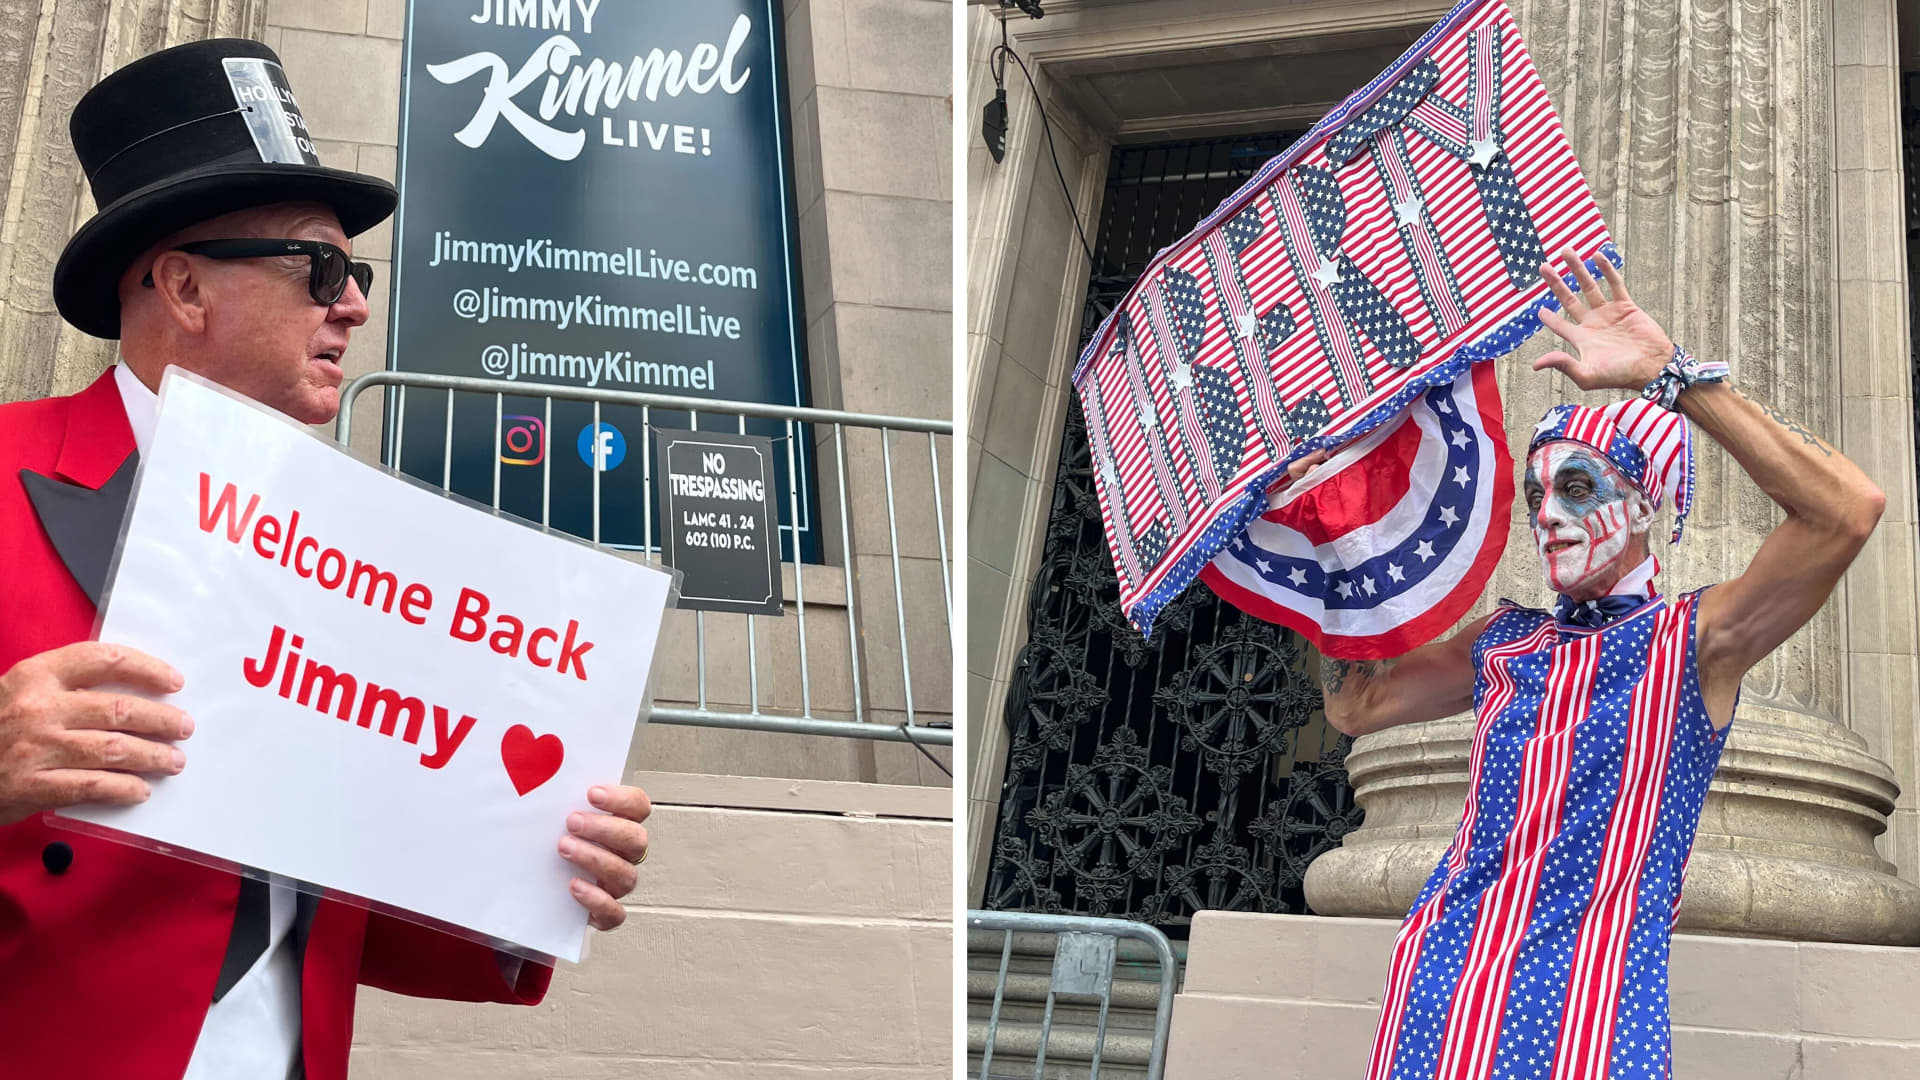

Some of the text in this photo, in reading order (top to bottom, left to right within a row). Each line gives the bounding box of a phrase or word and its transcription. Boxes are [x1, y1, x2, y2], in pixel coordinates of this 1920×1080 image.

[470, 0, 600, 34] JIMMY
[426, 13, 751, 161] Kimmel
[602, 117, 711, 156] LIVE!
[430, 232, 757, 289] JimmyKimmelLive.com
[453, 287, 740, 339] @JimmyKimmelLive
[1083, 23, 1548, 592] LIBERTY
[481, 343, 714, 390] @JimmyKimmel
[702, 451, 726, 475] NO
[670, 473, 764, 502] TRESPASSING
[683, 510, 716, 527] LAMC
[685, 531, 755, 550] 602 (10) P.C.
[199, 472, 595, 681] Welcome Back
[242, 624, 478, 769] Jimmy
